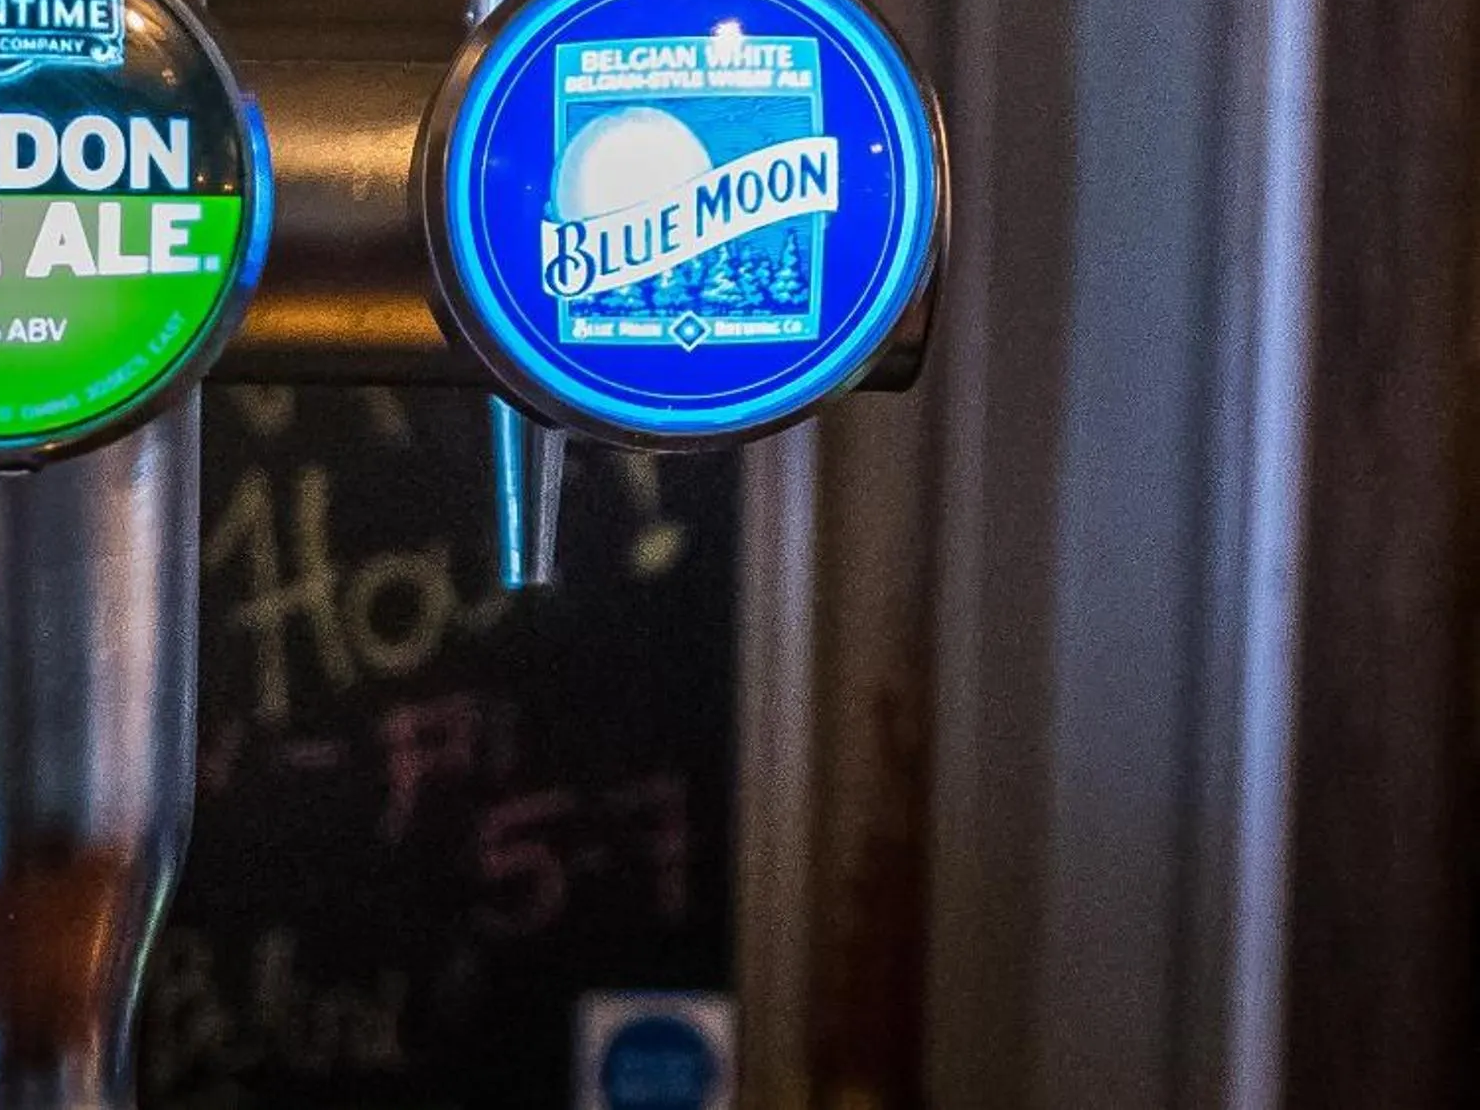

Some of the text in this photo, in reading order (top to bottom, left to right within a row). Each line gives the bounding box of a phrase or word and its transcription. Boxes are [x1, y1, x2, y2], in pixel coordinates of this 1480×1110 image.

[580, 43, 795, 74] BELGIAN WHITE
[24, 201, 221, 279] ALE.
[544, 151, 828, 298] BLUE MOON
[5, 316, 69, 344] ABV
